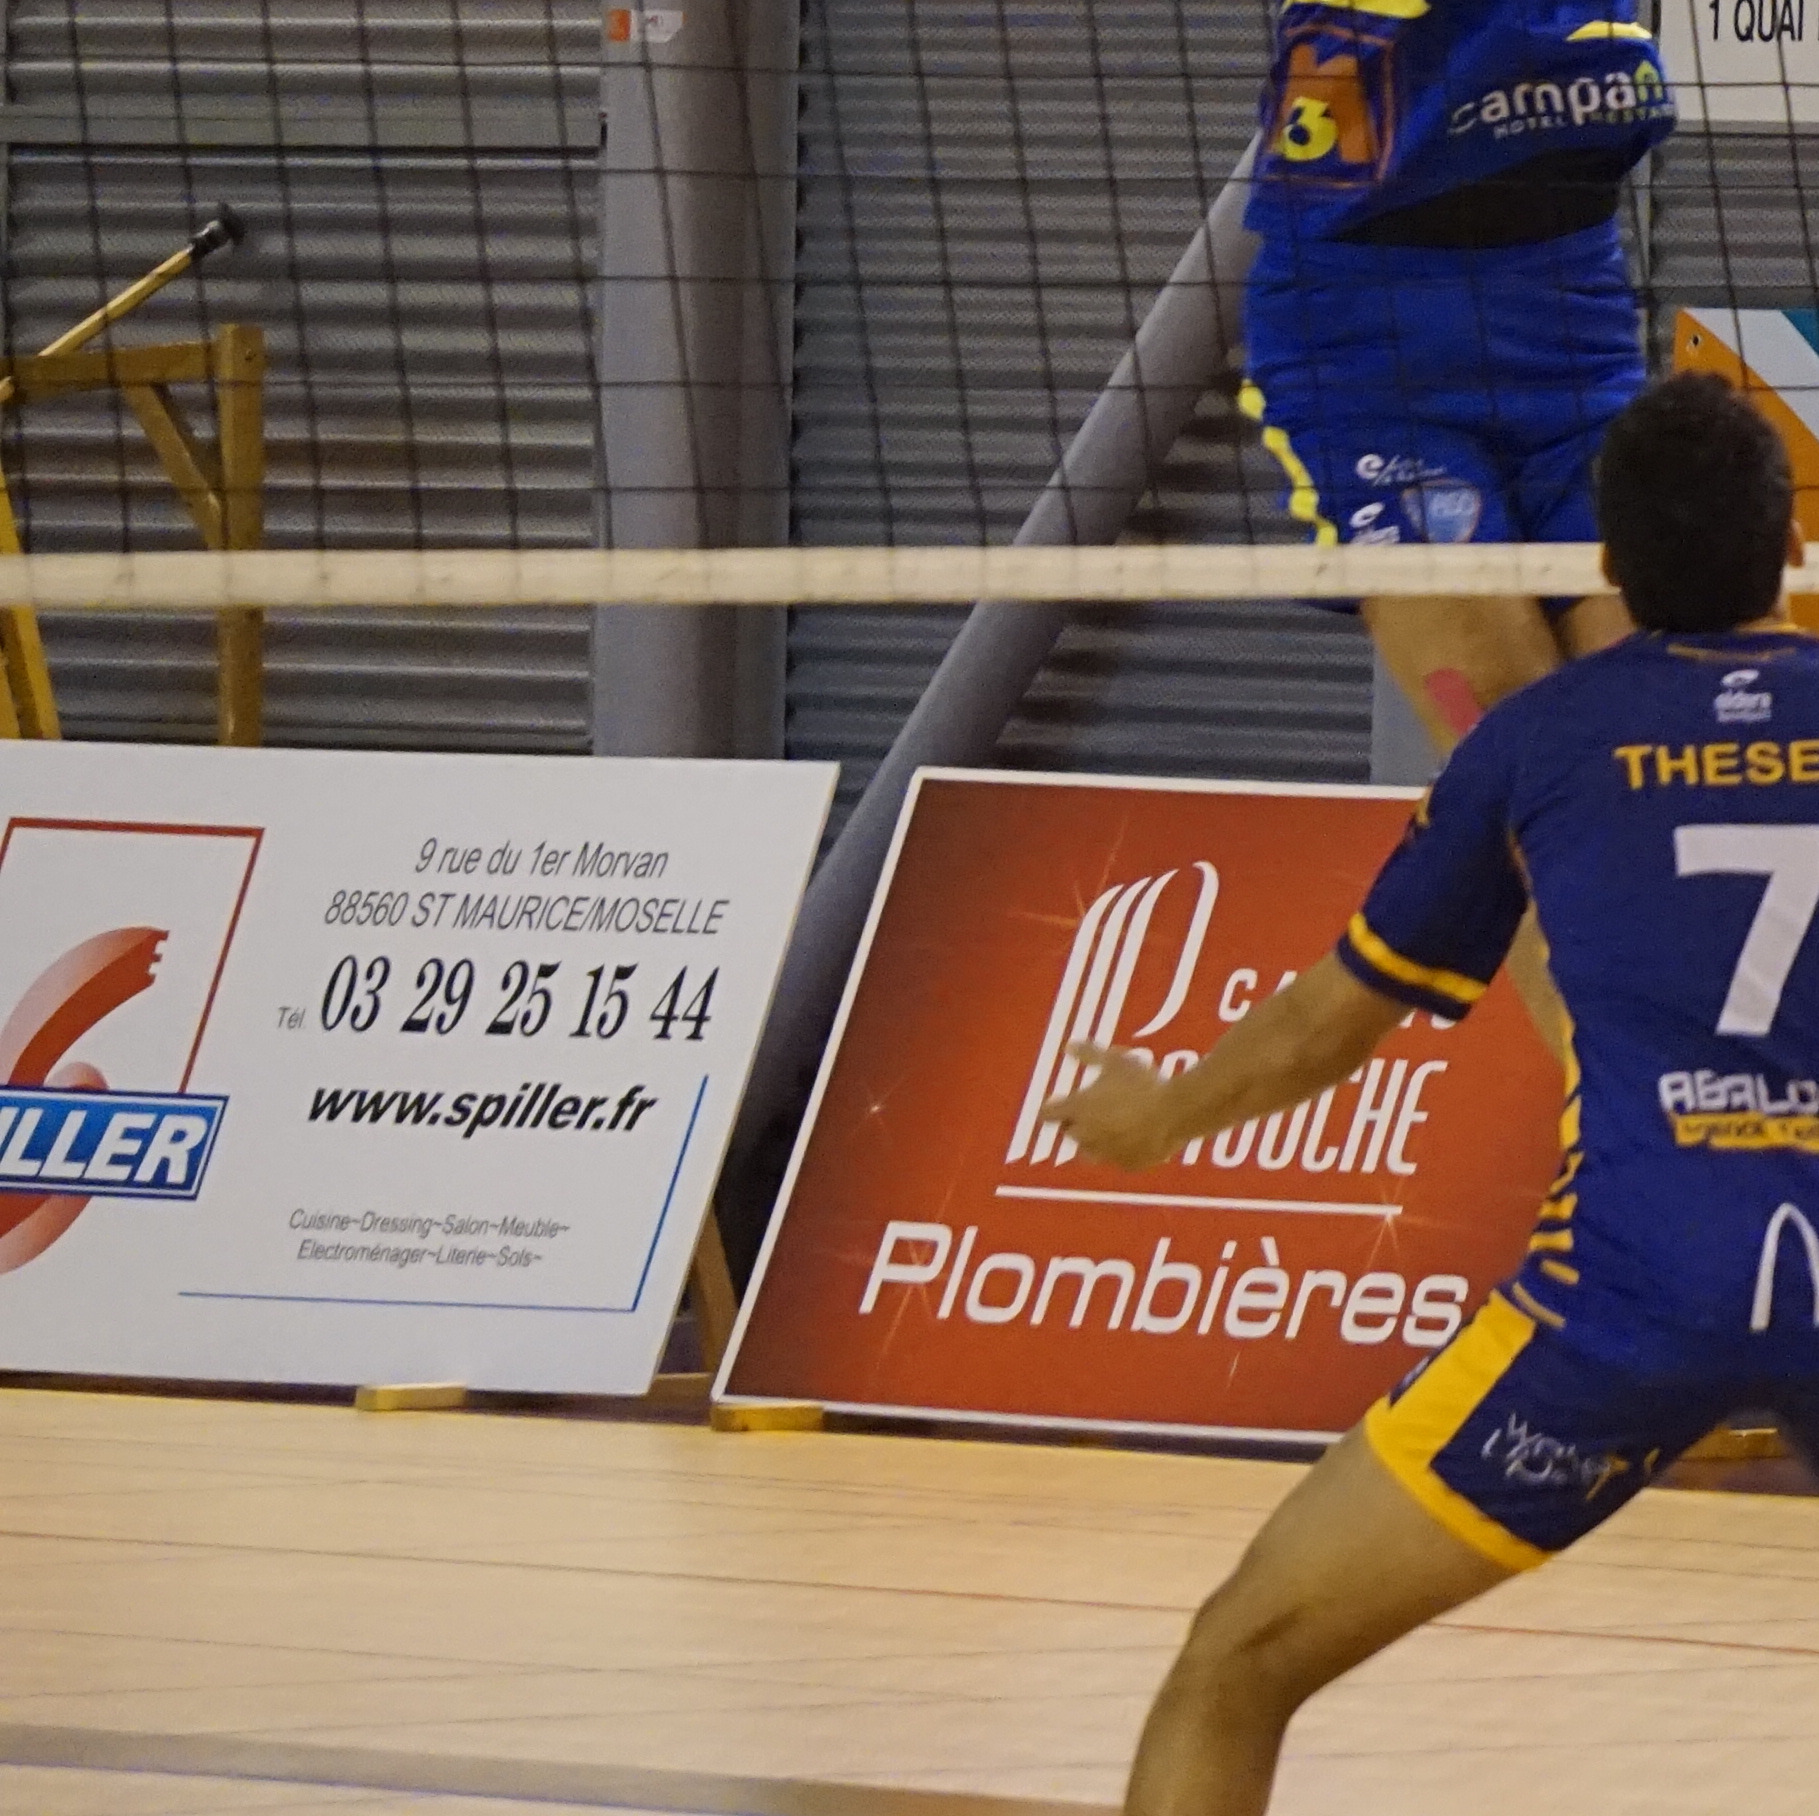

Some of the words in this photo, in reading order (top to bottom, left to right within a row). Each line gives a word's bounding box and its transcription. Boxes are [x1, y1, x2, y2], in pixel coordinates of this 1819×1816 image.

[415, 837, 438, 874] 9
[437, 848, 482, 875] rue
[487, 840, 523, 876] du
[528, 841, 570, 877] 1er
[572, 842, 669, 880] Morvan
[324, 889, 408, 927] 88560
[411, 892, 456, 928] ST
[451, 893, 731, 936] MAURICE/MOSELLE
[321, 954, 391, 1033] 03
[400, 957, 475, 1035] 29
[484, 959, 563, 1038] 25
[568, 962, 639, 1040] 15
[648, 964, 721, 1041] 44
[308, 1082, 658, 1140] www.spiller.fr
[860, 1221, 1468, 1350] Plombières
